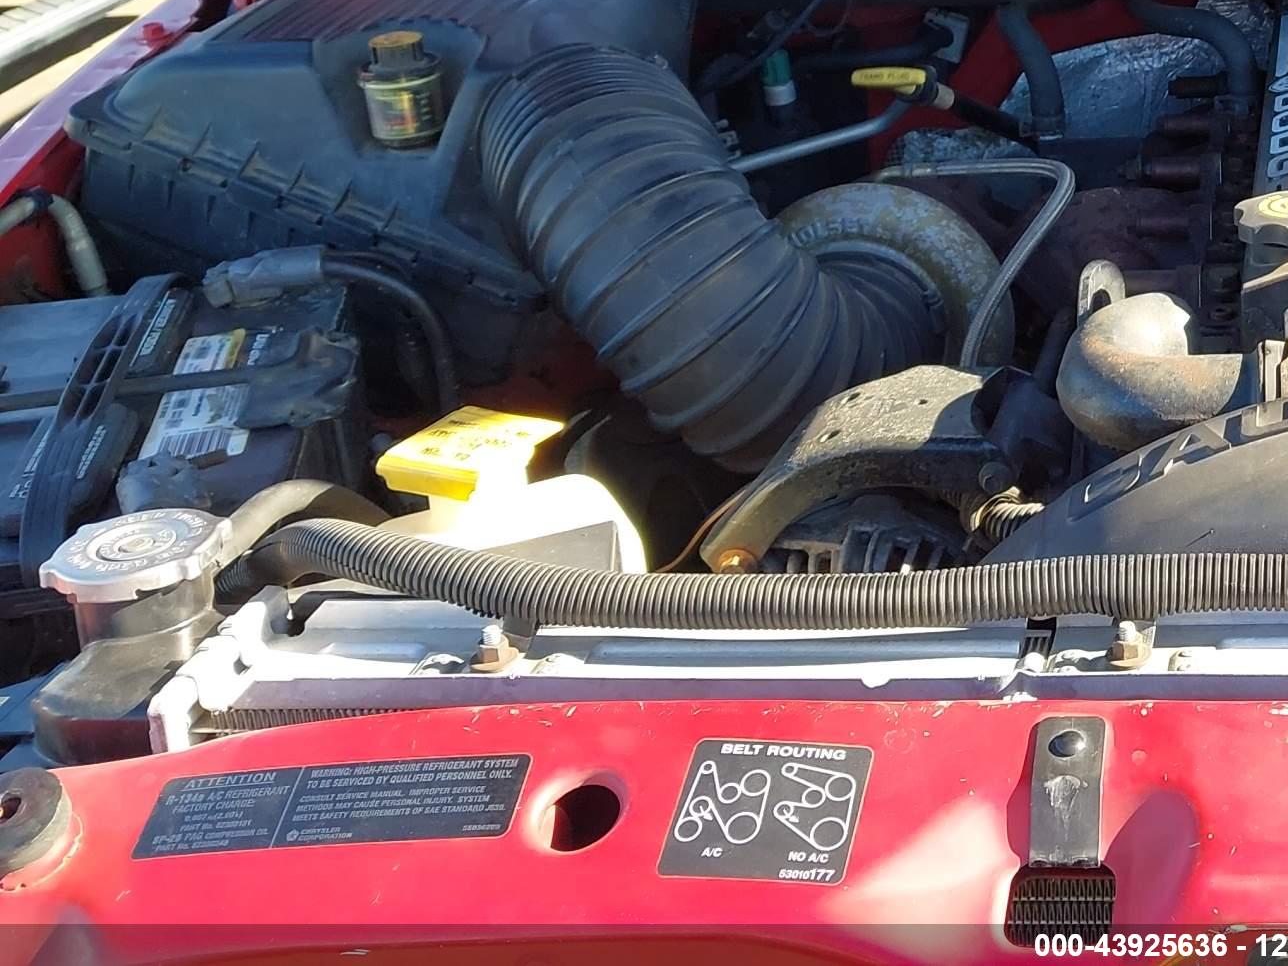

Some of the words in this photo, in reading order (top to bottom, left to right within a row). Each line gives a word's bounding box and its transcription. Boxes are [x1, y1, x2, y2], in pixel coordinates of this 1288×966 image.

[720, 743, 763, 756] BELT
[767, 745, 847, 760] ROUTING
[311, 767, 353, 779] WARNING:
[353, 762, 422, 776] HIGH-PRESSURE
[422, 759, 484, 772] REFRIGERANT
[483, 758, 519, 769] SYSTEM
[185, 772, 277, 789] ATTENTION
[306, 780, 319, 789] TO
[319, 779, 332, 789] BE
[332, 776, 375, 788] SERVICED
[375, 774, 390, 785] BY
[390, 773, 434, 784] QUALIFIED
[434, 770, 488, 782] PERSONNEL
[489, 769, 513, 779] ONLY.
[165, 793, 205, 806] R-134a
[225, 785, 291, 800] REFRIGERANT
[299, 793, 335, 803] CONSULT
[335, 791, 370, 801] SERVICE
[409, 787, 450, 796] IMPROPER
[451, 785, 487, 795] SERVICE
[334, 801, 353, 810] MAY
[353, 799, 379, 809] CAUSE
[380, 797, 421, 807] PERSONAL
[457, 794, 490, 803] SYSTEM
[172, 802, 215, 814] FACTORY
[292, 813, 319, 822] MEETS
[319, 811, 349, 820] SAFETY
[349, 808, 411, 818] REQUIREMENTS
[412, 806, 425, 815] OF
[424, 805, 441, 814] SAE
[441, 804, 485, 813] STANDARD
[298, 833, 353, 841] CORPORATION
[301, 826, 341, 835] CHRYSLER
[701, 847, 723, 858] A/C
[788, 851, 805, 862] NO
[808, 852, 829, 863] A/C
[779, 868, 835, 882] 53010177
